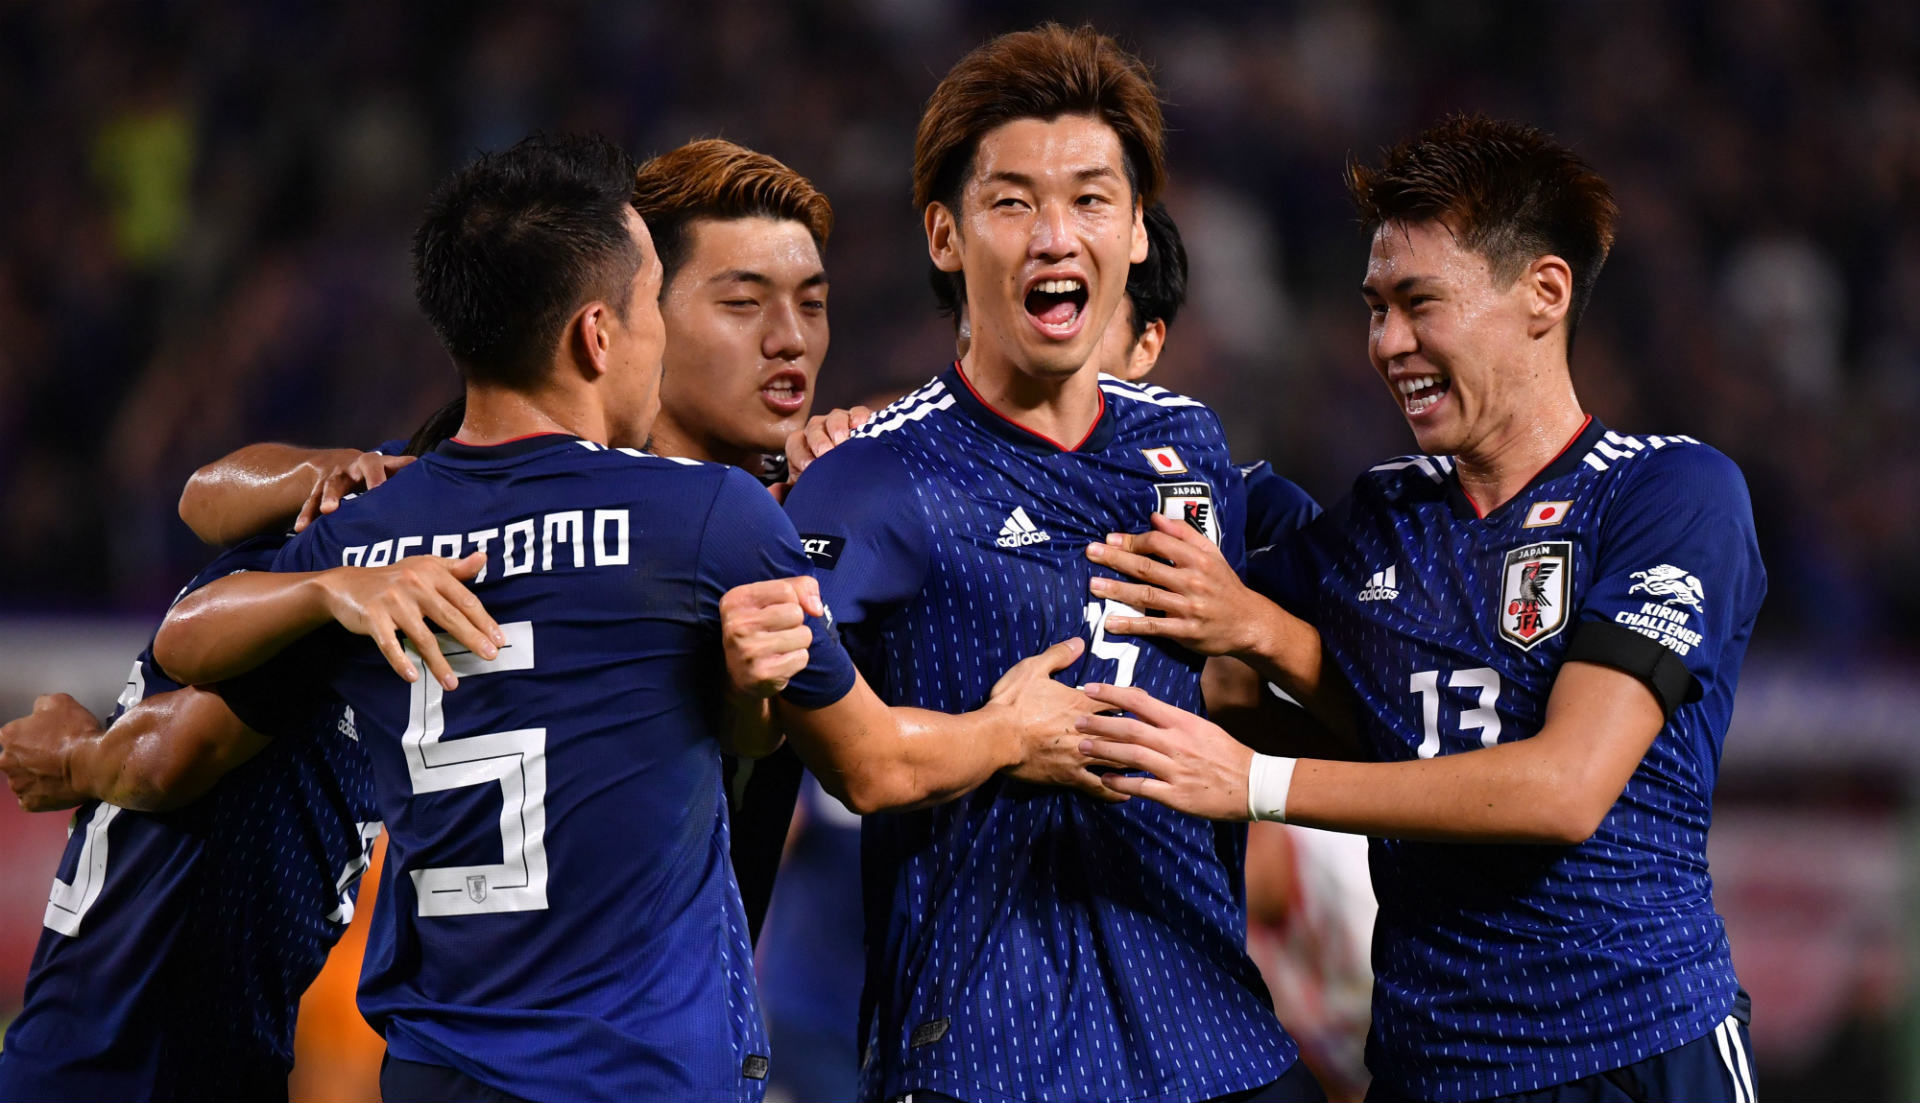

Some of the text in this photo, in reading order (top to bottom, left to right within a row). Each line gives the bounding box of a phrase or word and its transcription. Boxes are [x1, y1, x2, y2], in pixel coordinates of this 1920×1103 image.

[1173, 486, 1203, 495] JAPAN
[996, 530, 1051, 548] adidas
[1518, 546, 1551, 559] JAPAN
[1358, 585, 1400, 602] adidas
[1512, 613, 1544, 631] JFA
[1640, 602, 1690, 626] KIRIN
[1615, 611, 1703, 648] CHALLENGE
[1659, 633, 1690, 656] 2019
[1409, 667, 1501, 759] 13
[401, 620, 549, 917] 5
